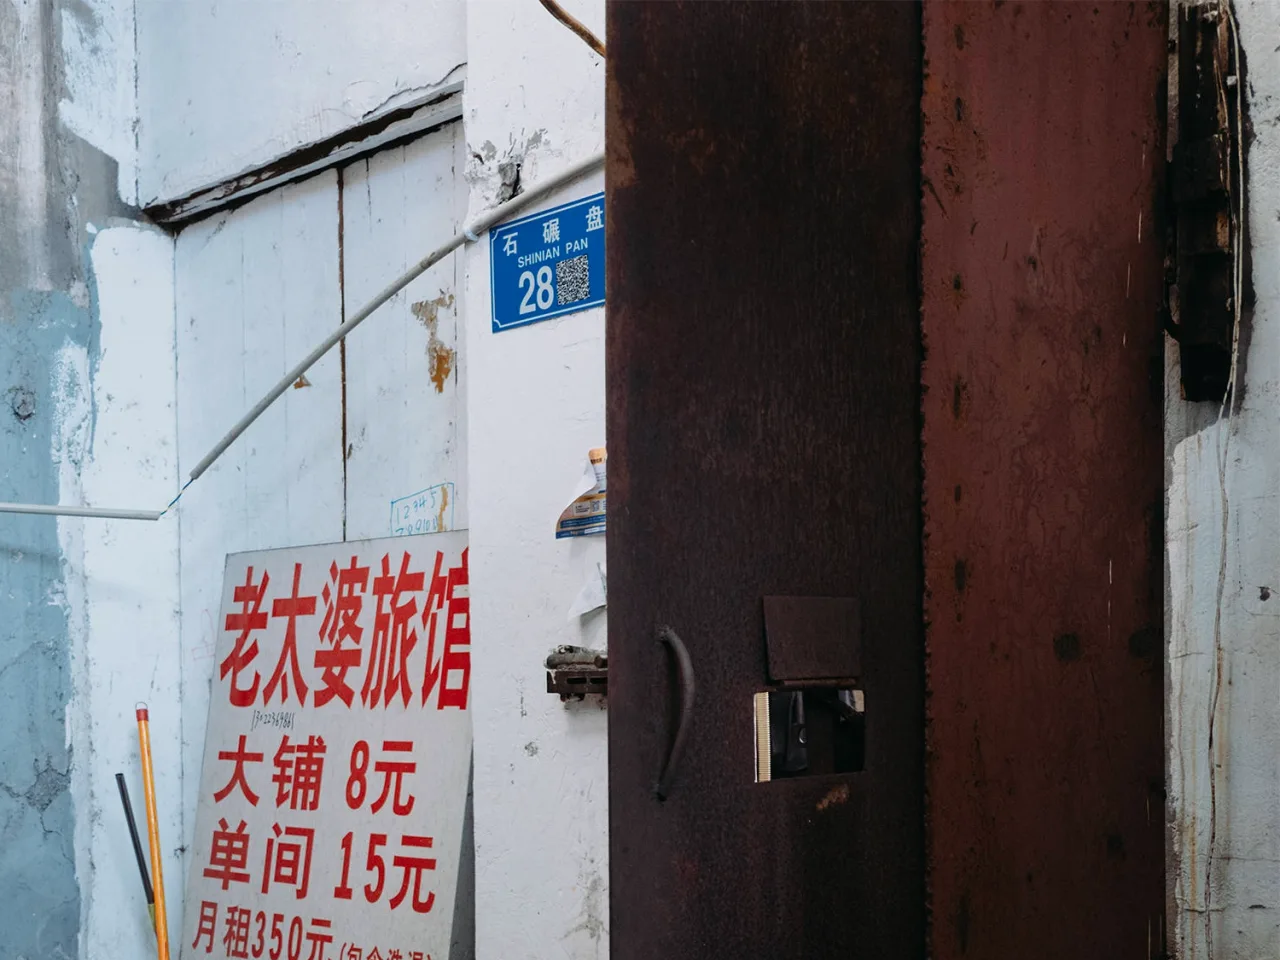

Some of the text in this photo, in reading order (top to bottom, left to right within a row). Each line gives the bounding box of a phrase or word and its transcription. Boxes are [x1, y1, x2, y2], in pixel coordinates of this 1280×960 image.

[502, 205, 605, 257] 石碾盘
[517, 237, 589, 268] SHINIAN PAN
[518, 265, 555, 315] 28
[219, 546, 470, 710] 老太婆旅馆
[213, 734, 417, 816] 大铺 8元
[203, 817, 437, 914] 单间 15元
